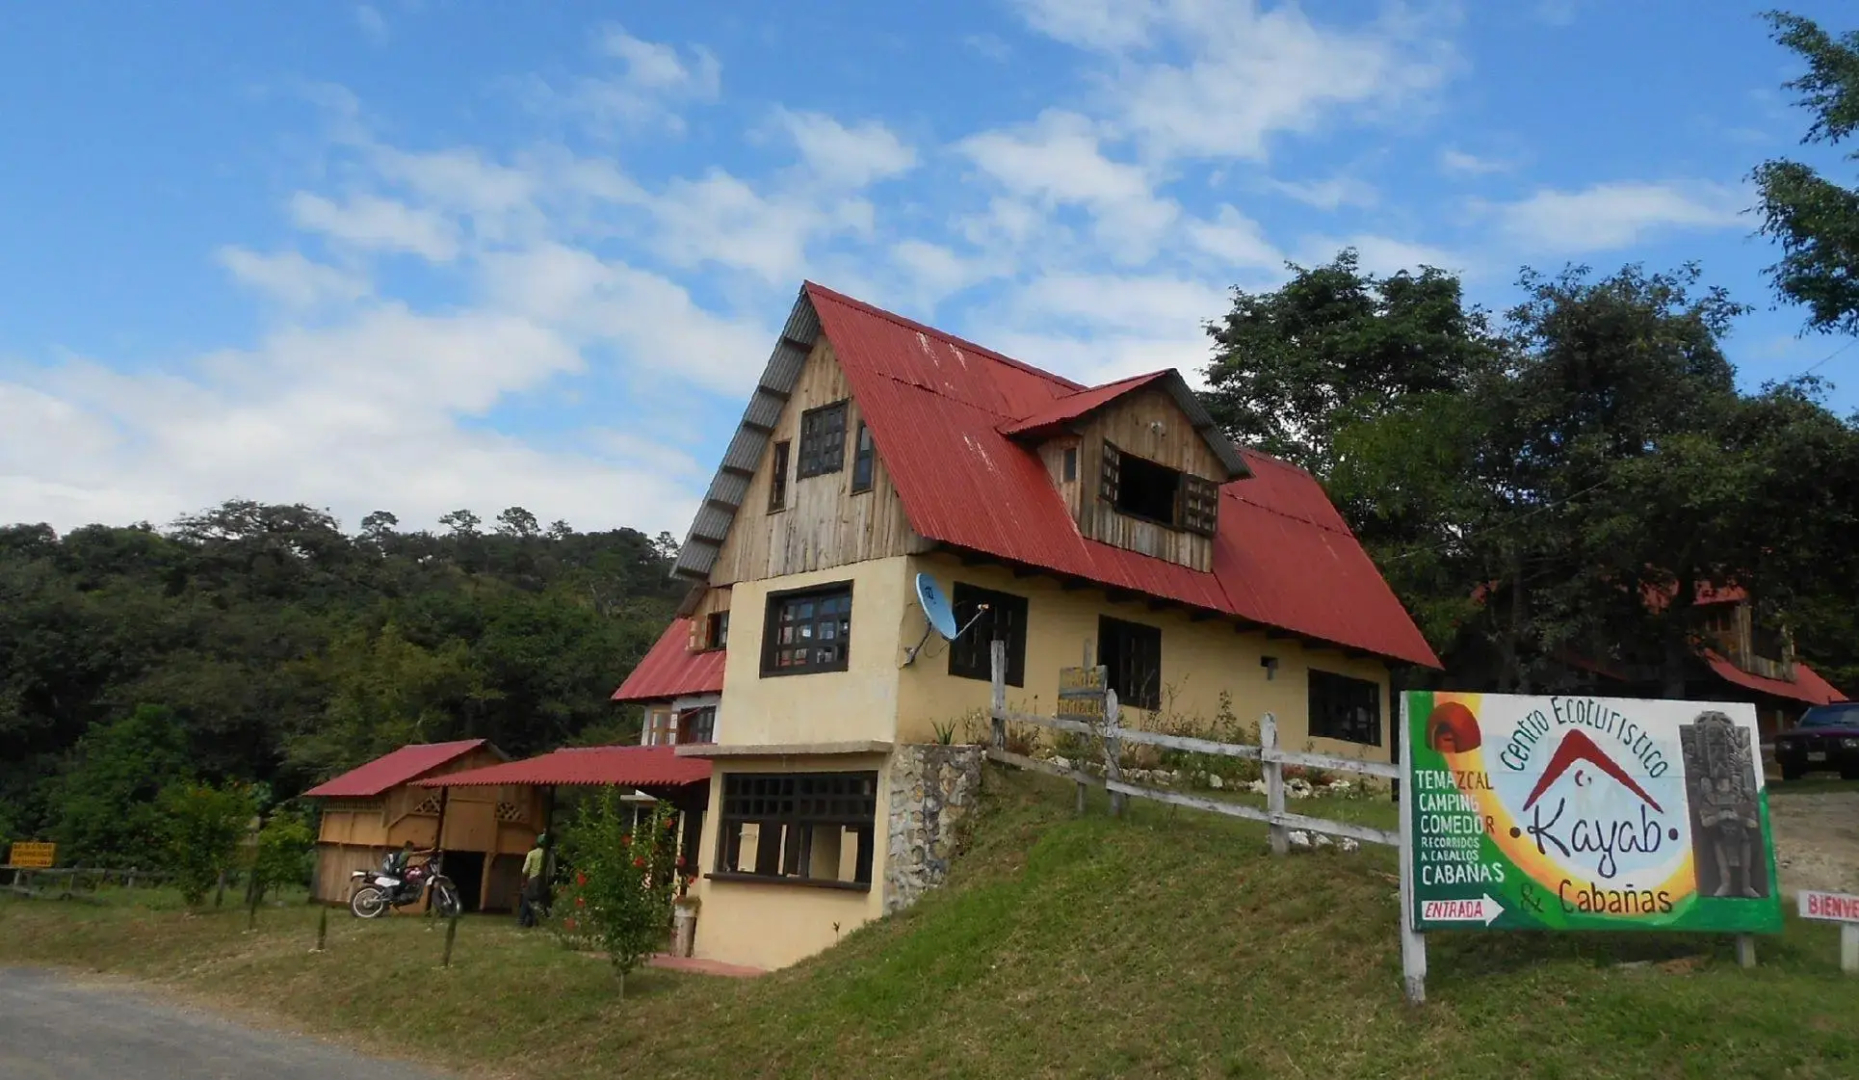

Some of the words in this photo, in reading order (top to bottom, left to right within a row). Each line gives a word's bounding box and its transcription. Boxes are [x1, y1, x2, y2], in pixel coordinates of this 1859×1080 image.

[1500, 709, 1550, 771] Centro
[1551, 696, 1669, 779] Ecoturistico
[1415, 770, 1494, 790] TEMAZCAL
[1419, 793, 1479, 812] CAMPING
[1420, 815, 1495, 834] COMEDOR
[1421, 836, 1480, 849] RECORRIDOS
[1527, 797, 1662, 879] Kayab
[1421, 851, 1428, 861] A
[1431, 850, 1480, 861] CABALLOS
[1422, 861, 1505, 885] CABAÑAS
[1559, 879, 1673, 914] Cabañas
[1425, 900, 1483, 918] ENTRADA
